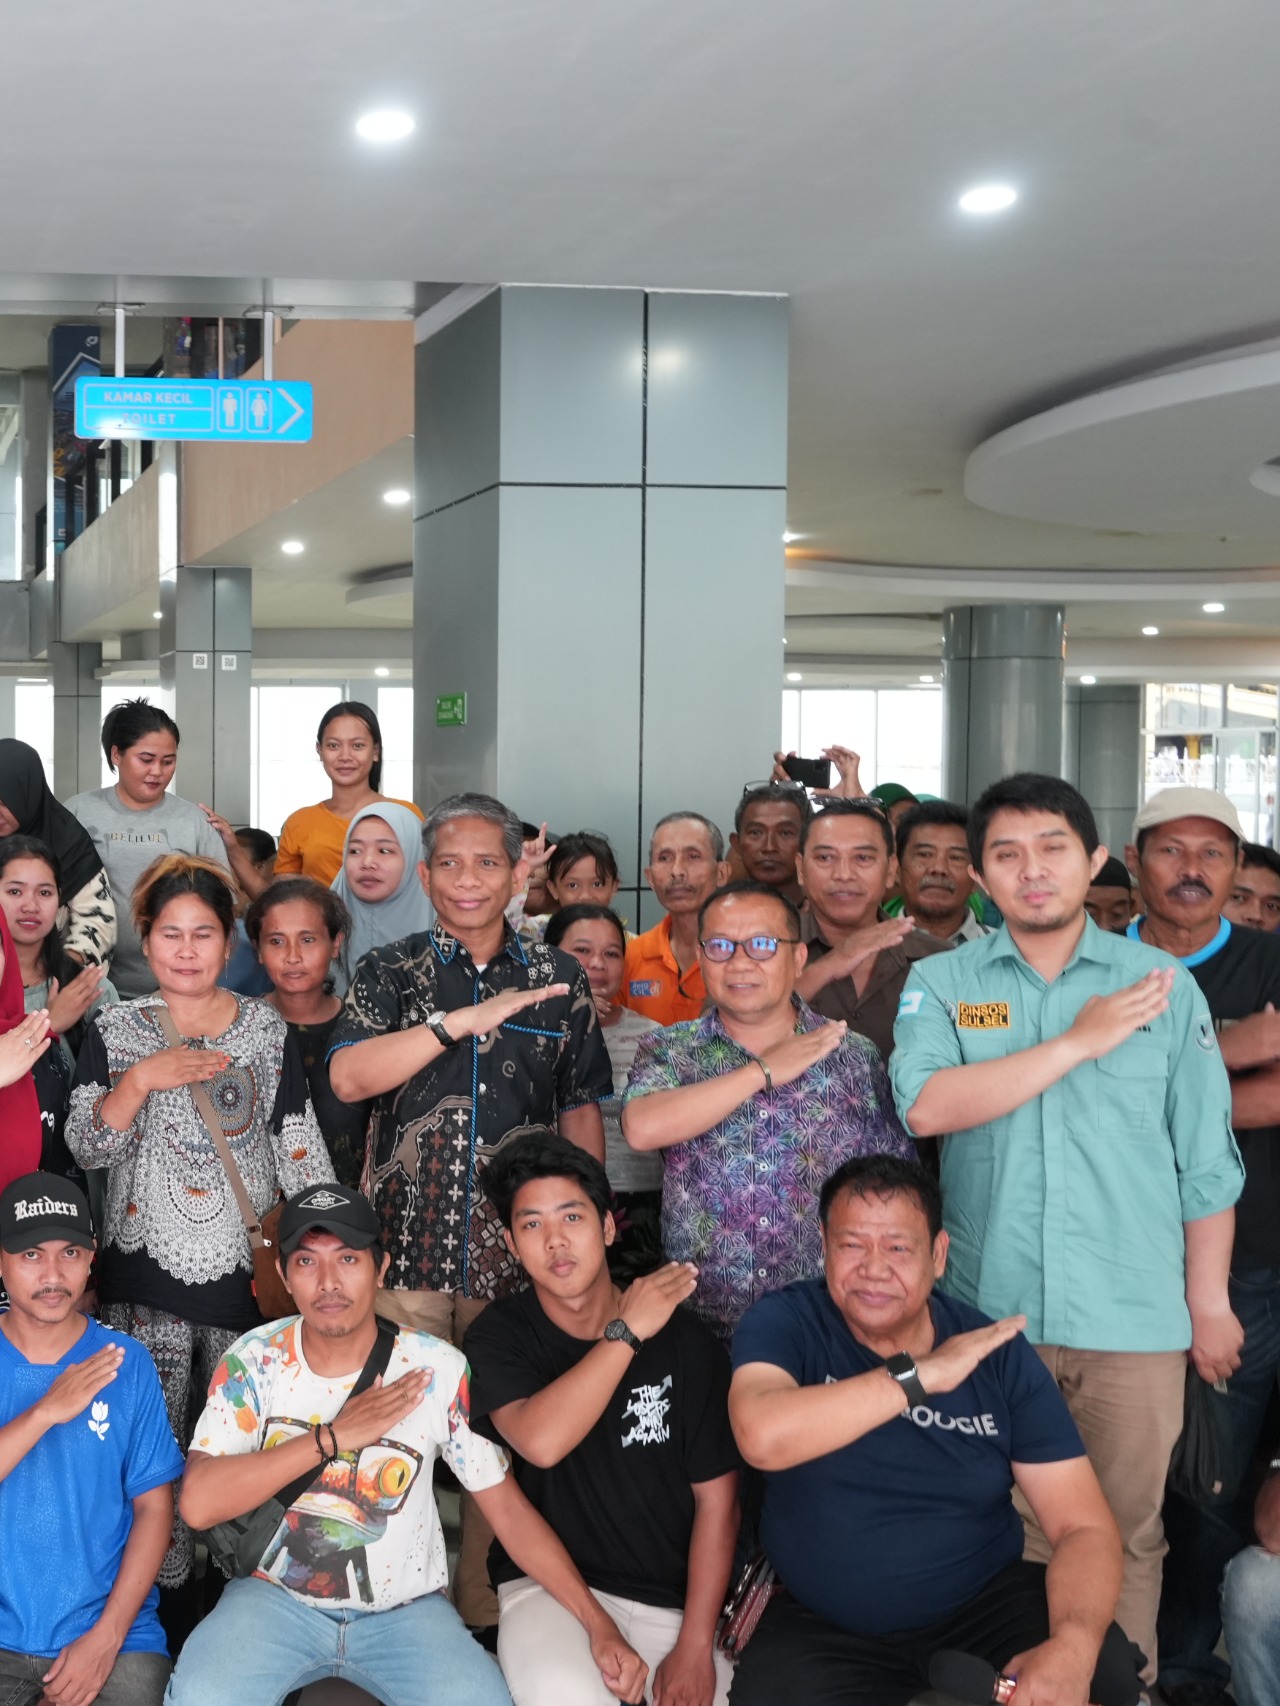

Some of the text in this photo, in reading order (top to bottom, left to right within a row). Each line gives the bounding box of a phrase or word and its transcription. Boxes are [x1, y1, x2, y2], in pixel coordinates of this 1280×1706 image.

[104, 392, 193, 404] KAMAR KECIL
[122, 413, 176, 425] TOILET
[110, 833, 163, 843] BELIEVE
[960, 1004, 1007, 1016] DINSOS
[960, 1015, 1007, 1025] SULSEL
[14, 1196, 78, 1221] Raiders
[631, 1385, 661, 1404] THE
[639, 1412, 663, 1430] WIN
[627, 1424, 670, 1446] AGAIN
